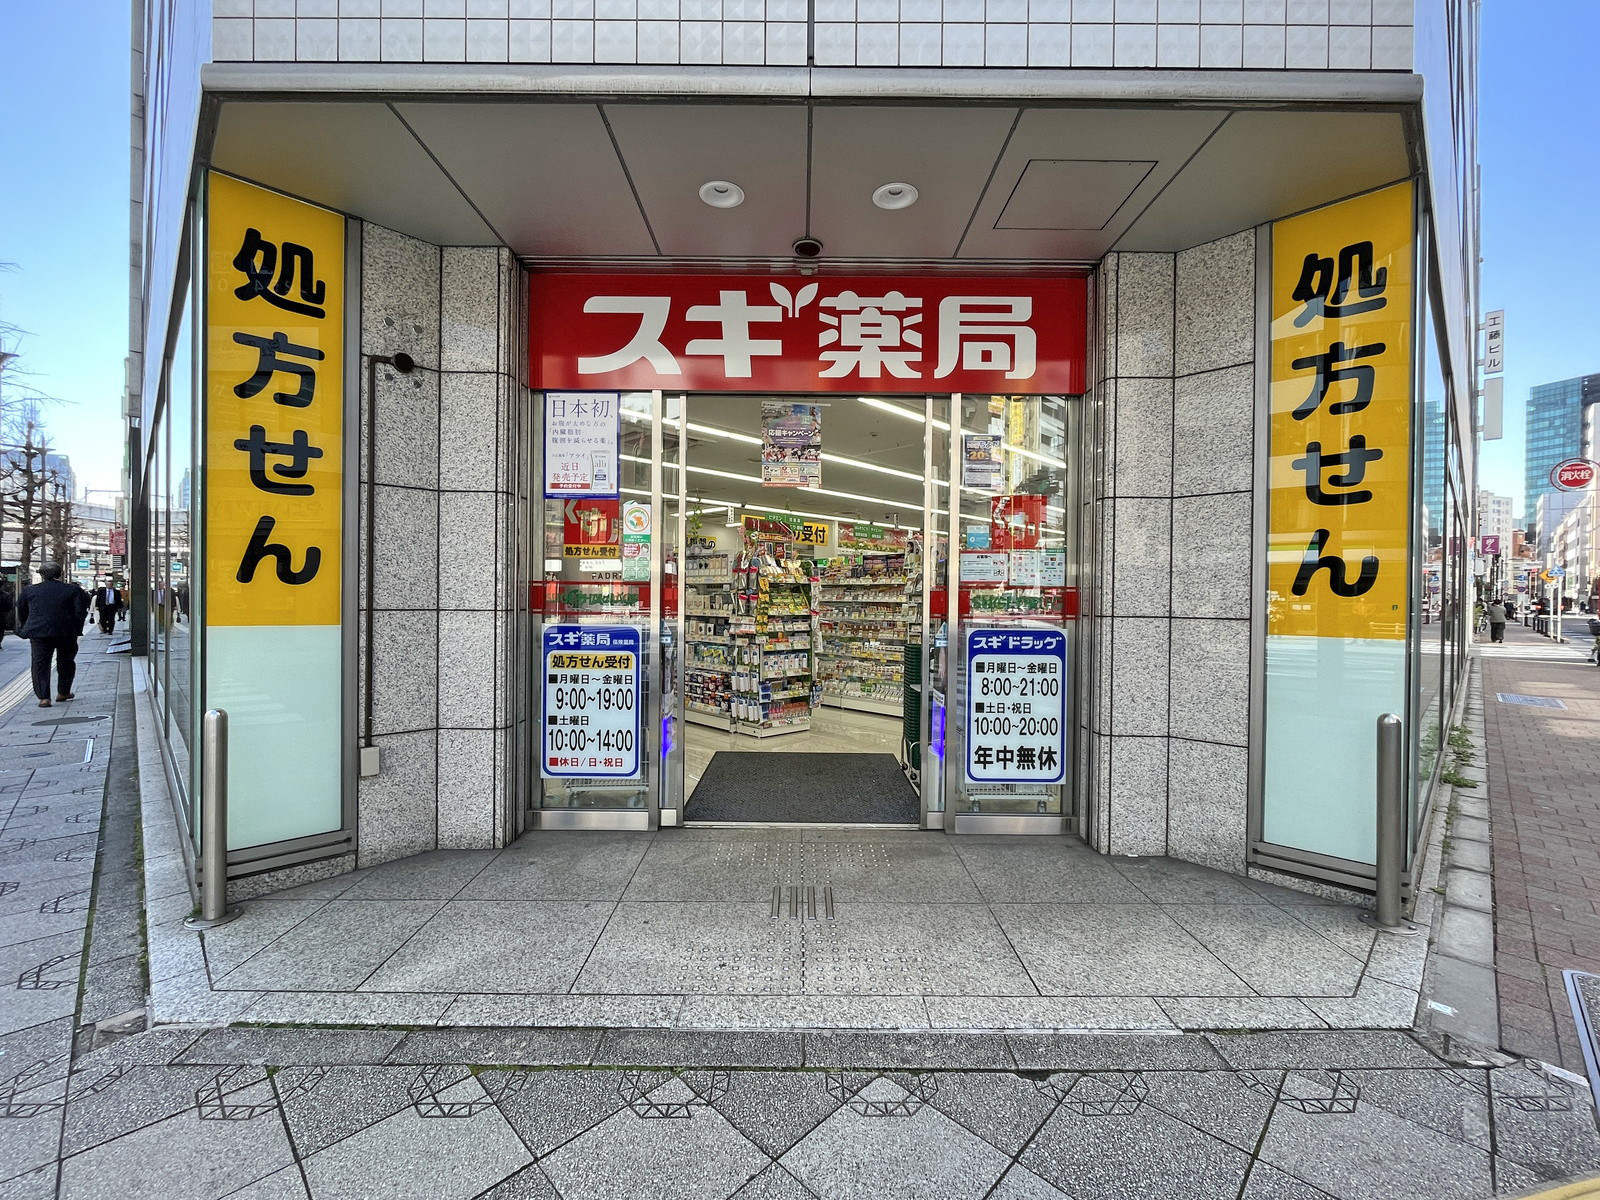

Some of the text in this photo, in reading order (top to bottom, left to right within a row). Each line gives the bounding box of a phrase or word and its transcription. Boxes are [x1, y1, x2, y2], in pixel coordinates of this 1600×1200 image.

[577, 282, 1037, 379] スギ薬局
[1488, 316, 1501, 368] 工藤ビル
[233, 228, 326, 585] 処方せん
[552, 399, 613, 418] 日本初、
[1291, 241, 1388, 598] 処方せん
[561, 462, 579, 471] 近日
[552, 473, 588, 481] 発売予定
[1560, 469, 1591, 481] 消火栓
[565, 547, 616, 556] 処方せん受付
[549, 631, 610, 646] スギ薬局
[552, 655, 630, 668] 処方せん受付
[559, 716, 589, 726] 土曜日
[974, 745, 1057, 770] 年中無休
